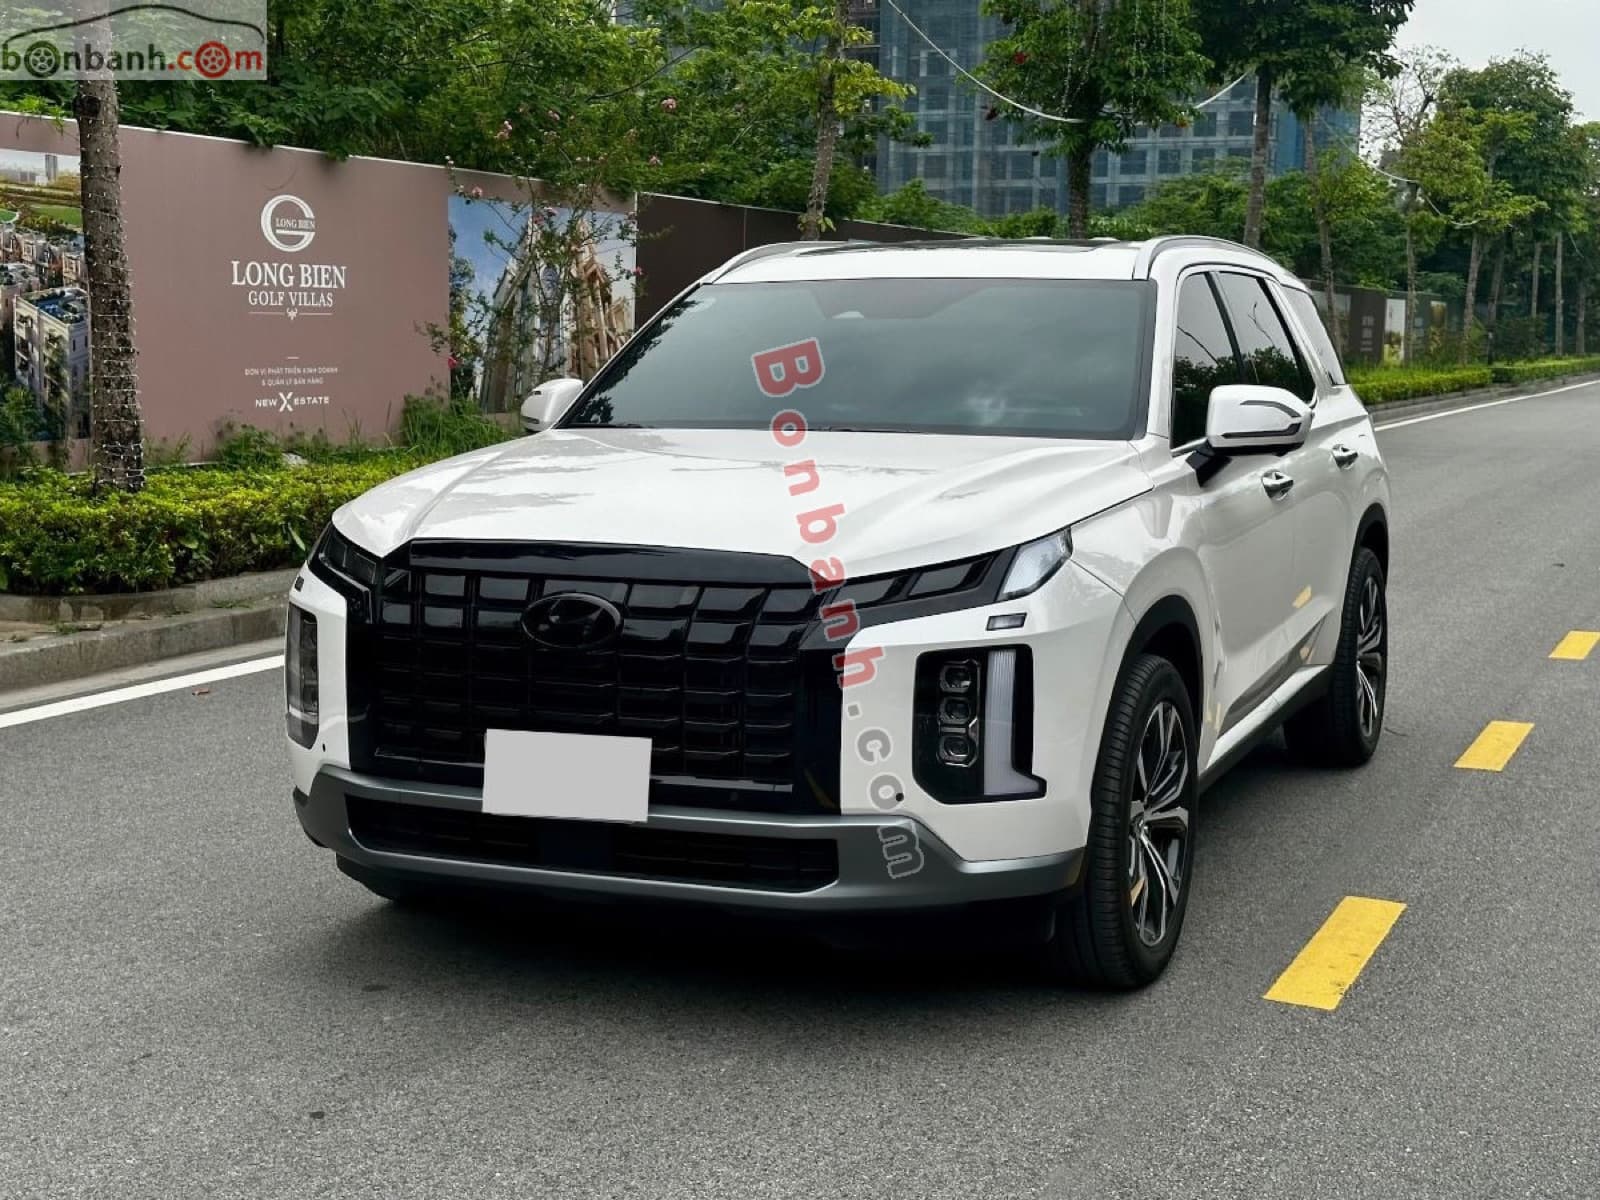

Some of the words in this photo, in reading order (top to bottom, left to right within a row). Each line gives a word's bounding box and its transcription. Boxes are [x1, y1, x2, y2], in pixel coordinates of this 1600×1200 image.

[231, 260, 295, 288] LONG
[299, 263, 347, 289] BIEN
[248, 290, 285, 306] GOLF
[288, 291, 334, 307] VILLAS
